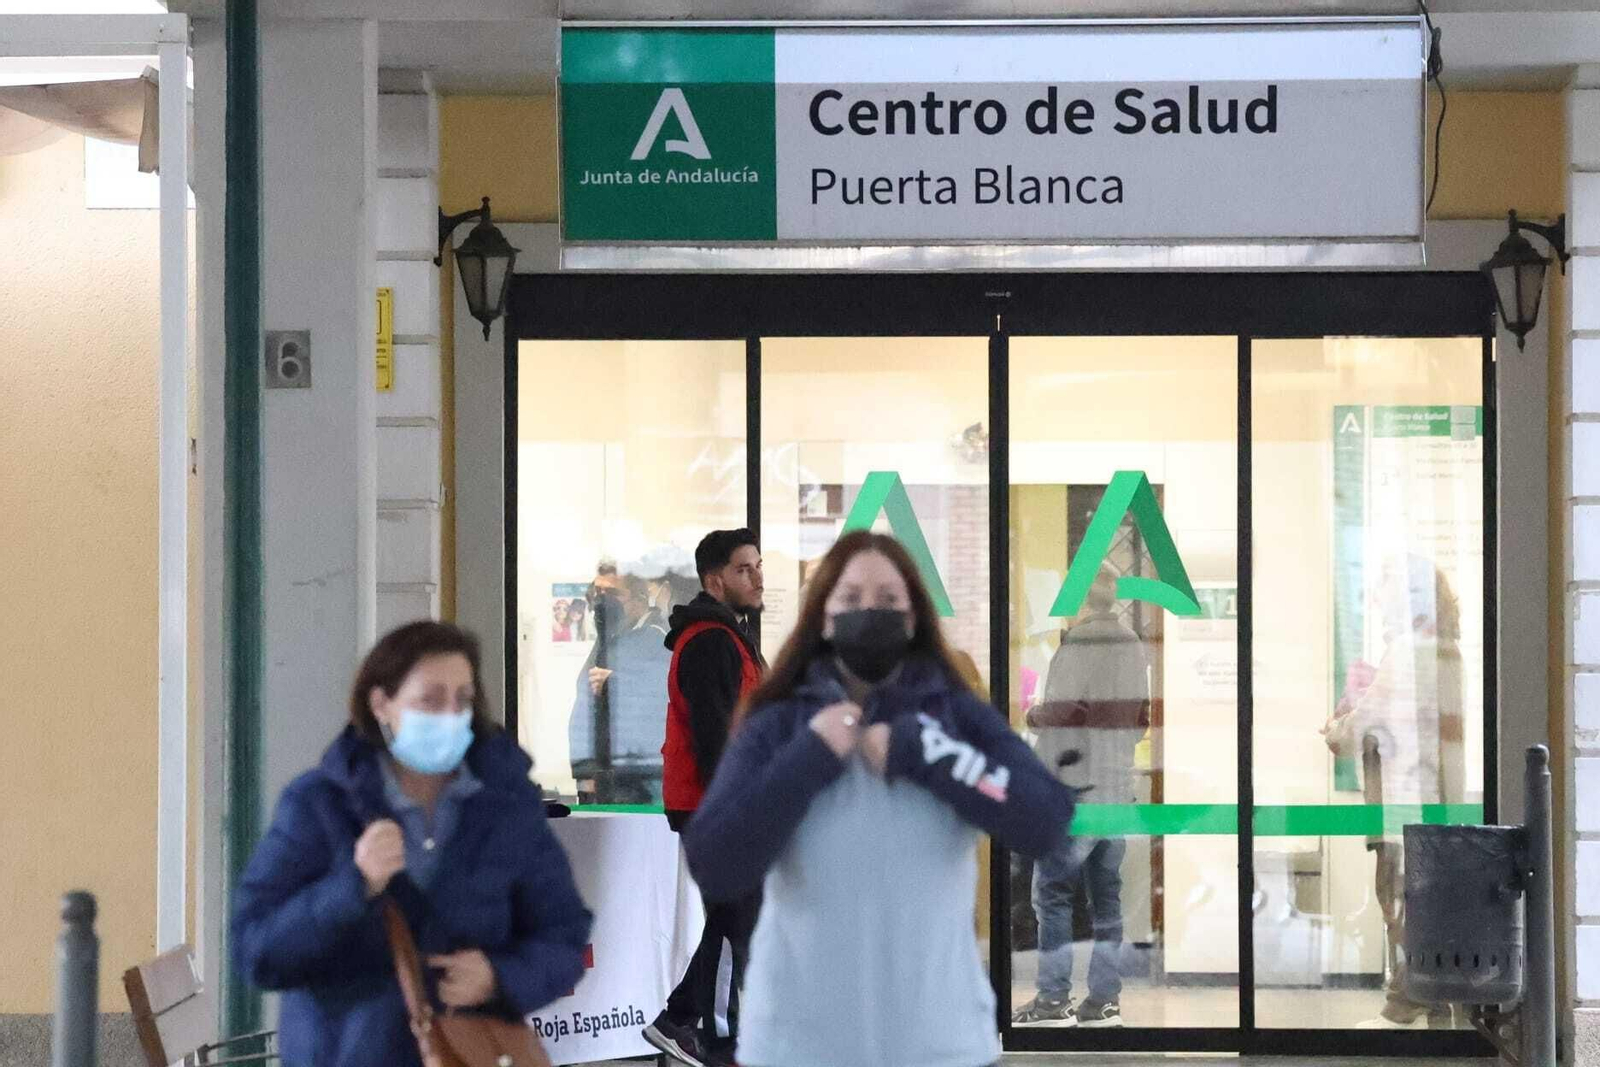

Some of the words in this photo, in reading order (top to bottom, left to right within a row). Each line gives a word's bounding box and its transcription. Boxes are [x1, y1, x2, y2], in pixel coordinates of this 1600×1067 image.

[808, 88, 1007, 136] Centro
[1025, 85, 1095, 136] de
[1113, 84, 1278, 136] Salud
[580, 169, 633, 187] Junta
[638, 169, 662, 185] de
[666, 166, 760, 185] Andalucía
[811, 168, 957, 206] Puerta
[974, 164, 1125, 206] Blanca
[532, 1016, 570, 1043] Roja
[572, 1005, 646, 1038] Española
